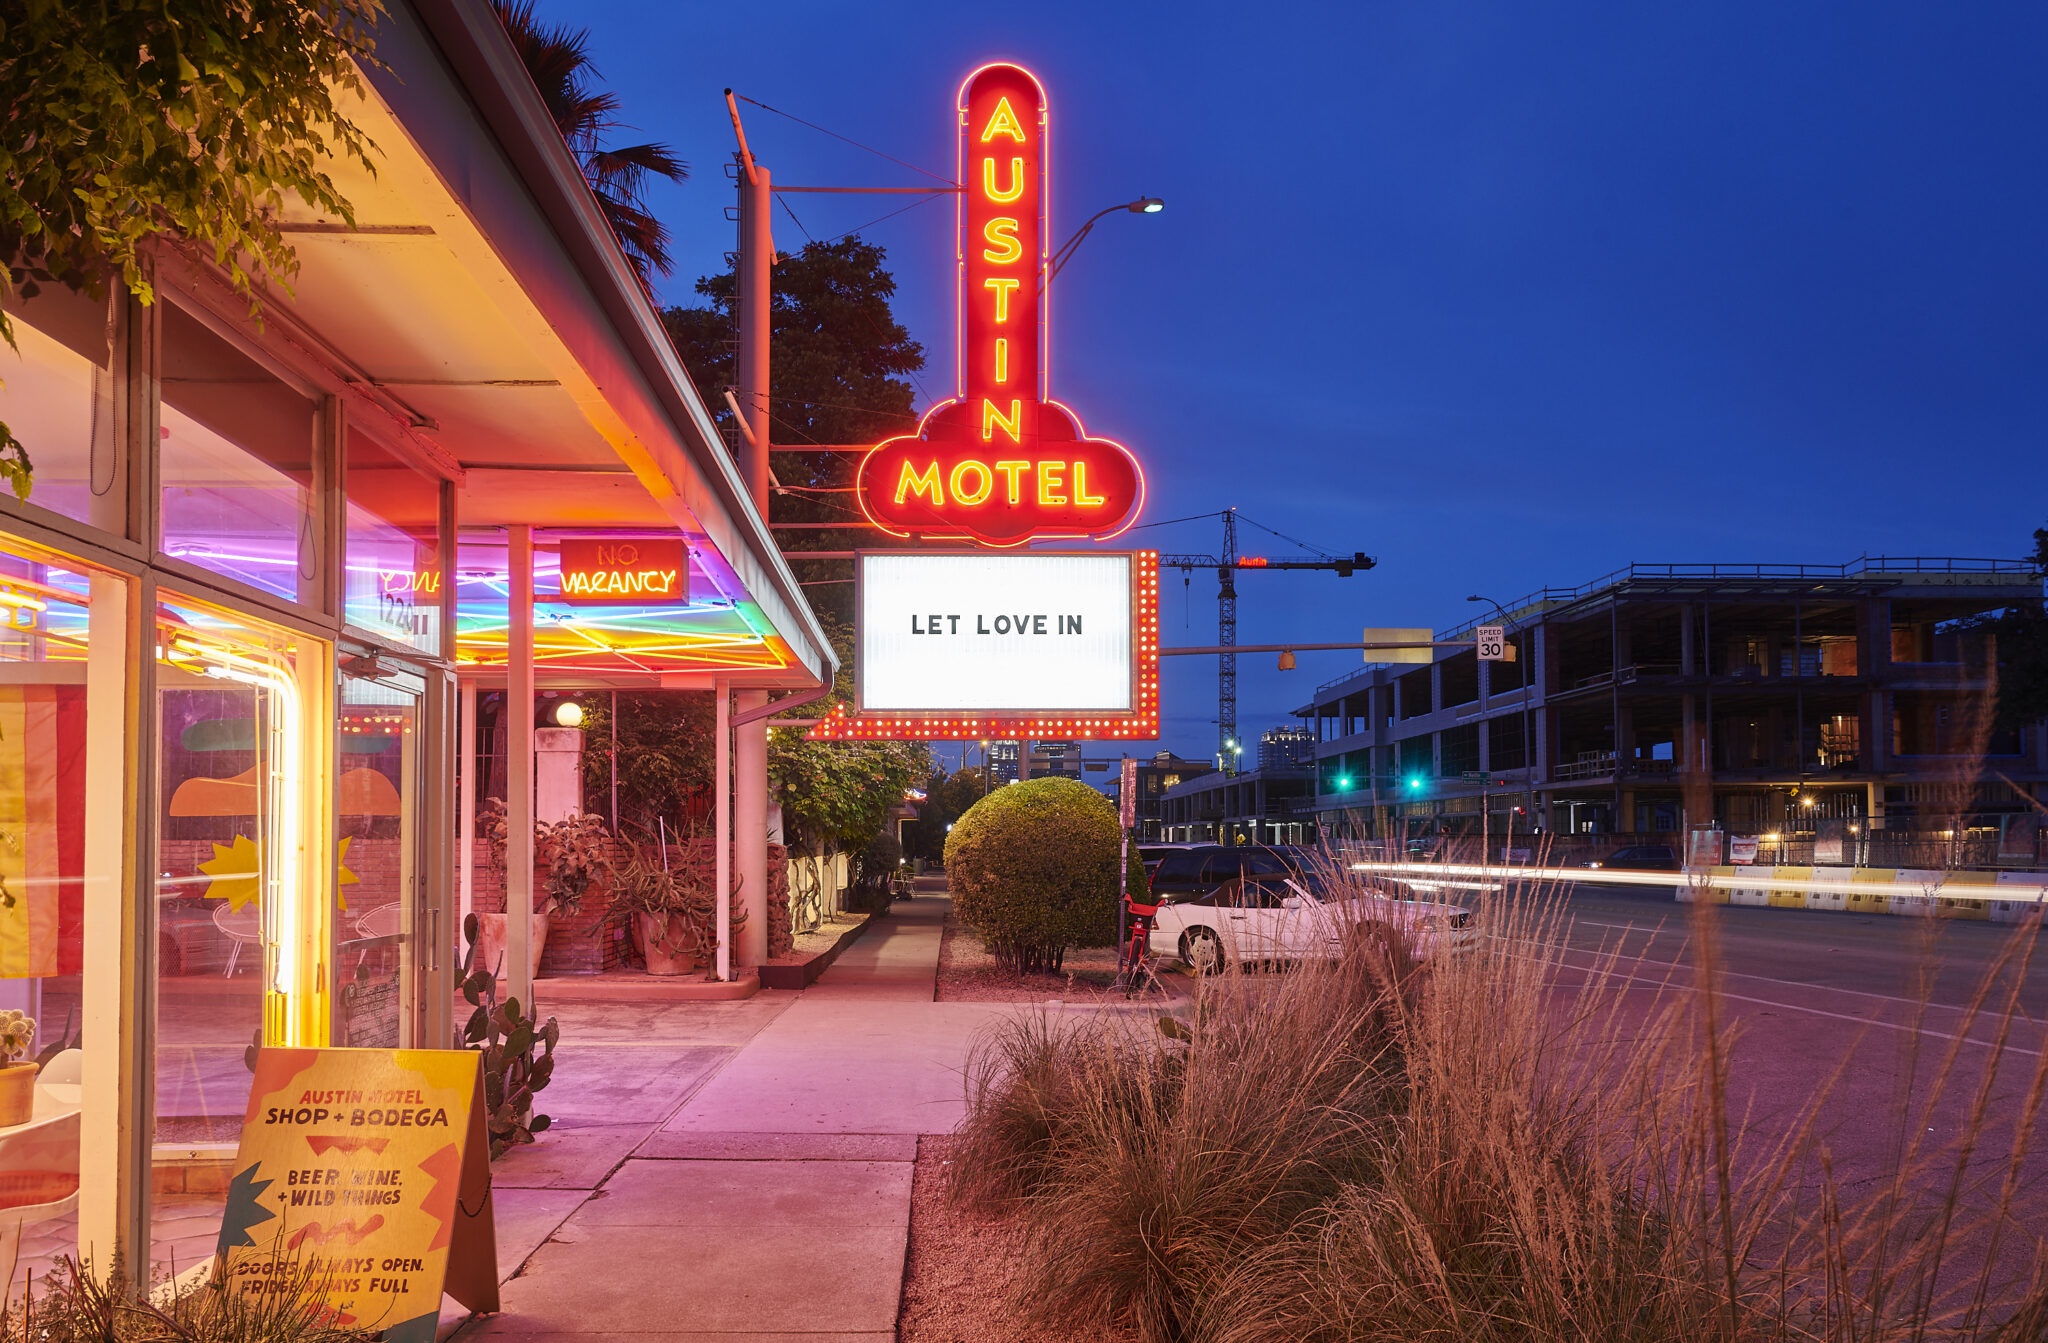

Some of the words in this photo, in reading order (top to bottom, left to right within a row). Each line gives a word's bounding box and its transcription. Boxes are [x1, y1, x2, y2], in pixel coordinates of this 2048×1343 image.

[981, 96, 1026, 444] AUSTIN
[894, 459, 1105, 506] MOTEL
[598, 544, 639, 566] NO
[560, 569, 676, 594] VACANCY
[912, 614, 960, 635] LET
[977, 614, 1047, 635] LOVE
[1058, 614, 1083, 635] IN
[1481, 643, 1501, 657] 30
[299, 1090, 364, 1105] AUSTIN
[368, 1089, 424, 1105] MOTEL
[265, 1107, 329, 1125] SHOP
[333, 1112, 345, 1122] +
[350, 1107, 449, 1127] BODEGA
[343, 1189, 401, 1207] THINGS
[236, 1260, 299, 1276] DOORS
[303, 1257, 375, 1274] ALWAYS
[381, 1257, 425, 1273] OPEN.
[368, 1277, 409, 1294] FULL
